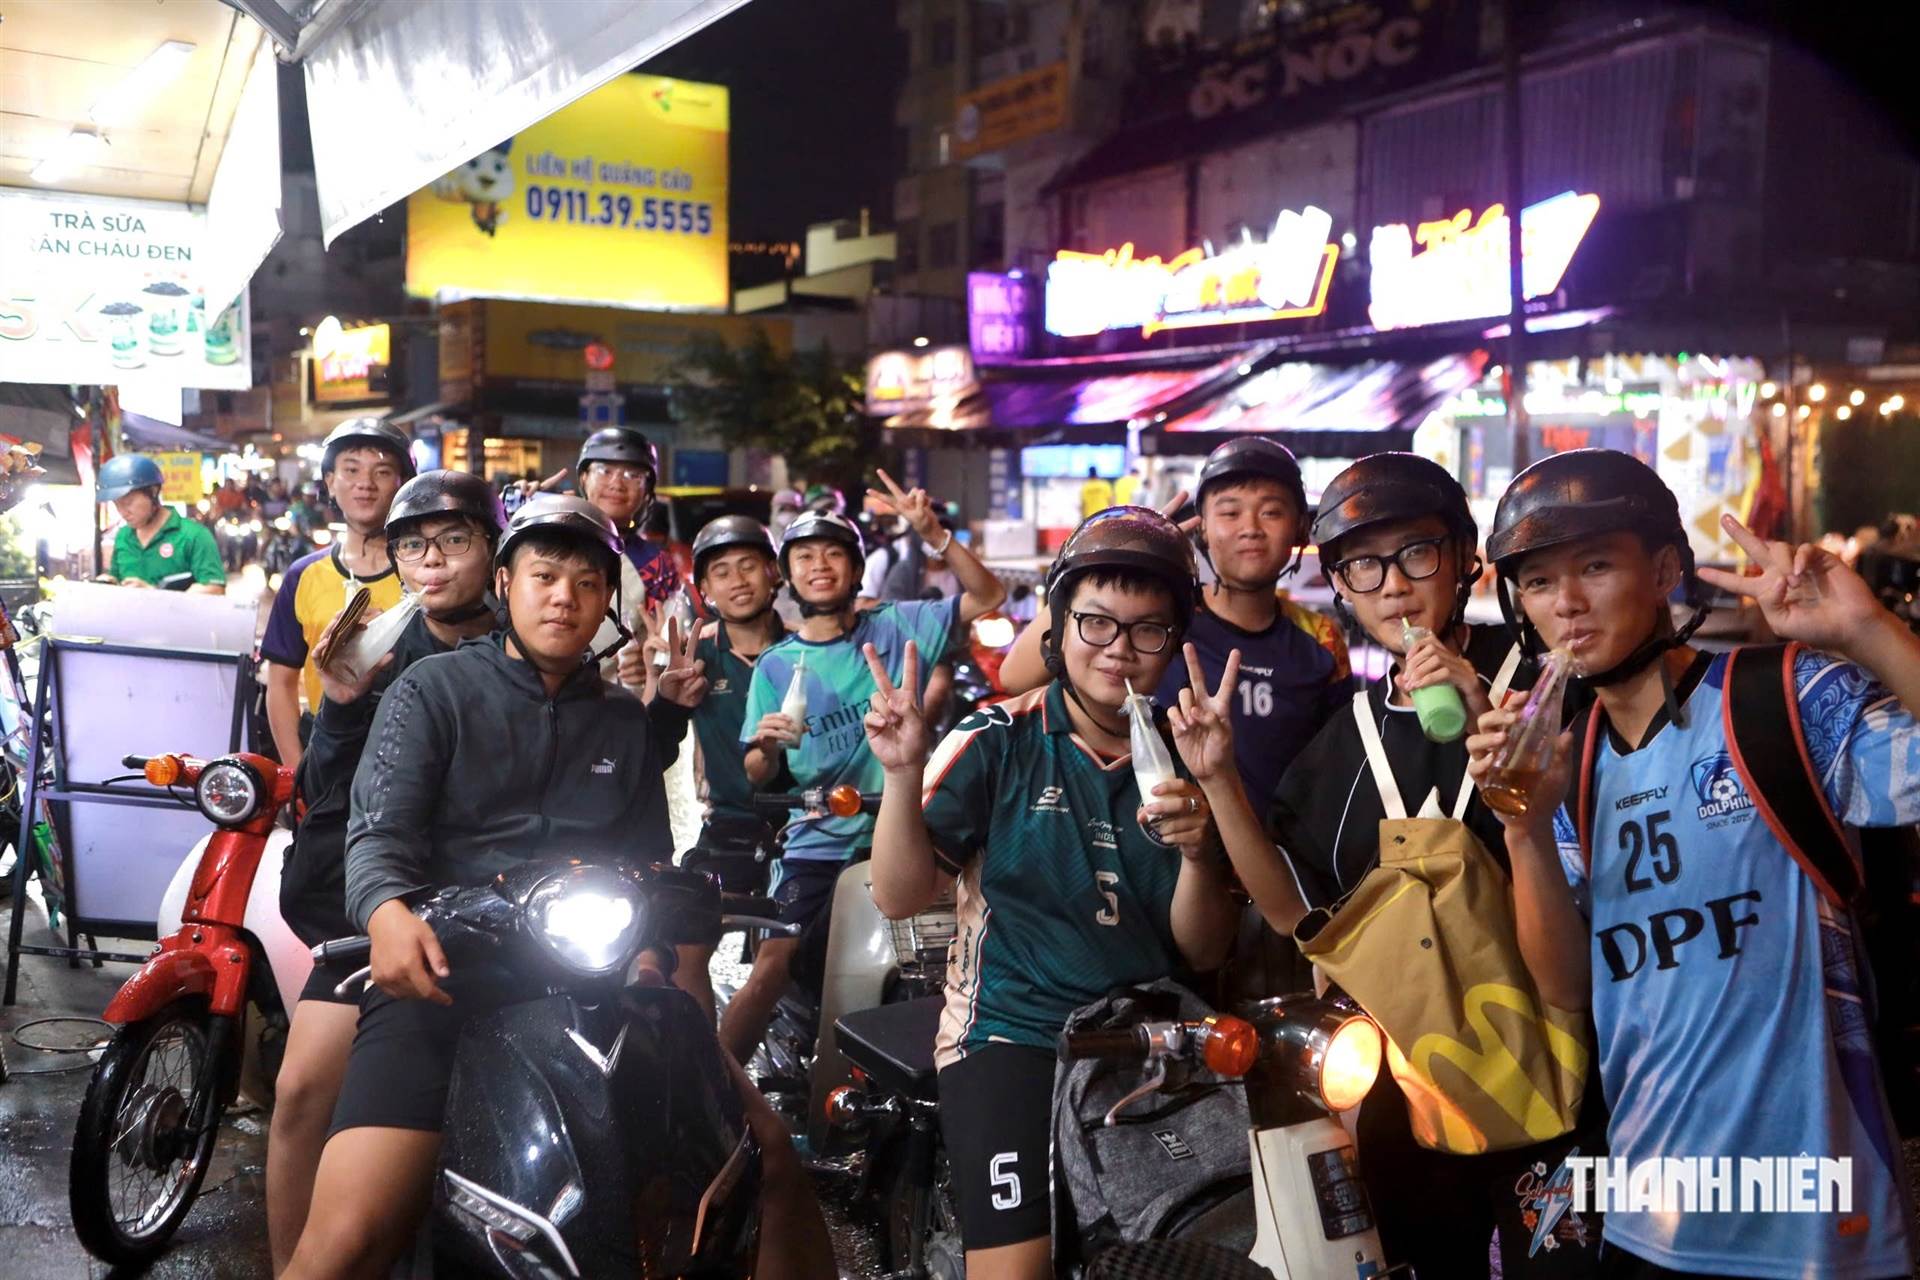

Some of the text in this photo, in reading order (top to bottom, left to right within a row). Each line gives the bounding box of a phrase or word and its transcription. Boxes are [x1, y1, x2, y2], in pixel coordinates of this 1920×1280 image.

[50, 210, 147, 234] TRÀ SỮA
[527, 185, 712, 235] 0911.39.5555
[147, 244, 192, 262] ĐEN
[1238, 680, 1274, 718] 16
[1618, 810, 1681, 896] 25
[1095, 870, 1120, 926] 5
[1596, 890, 1763, 984] DPF
[990, 1151, 1022, 1211] 5
